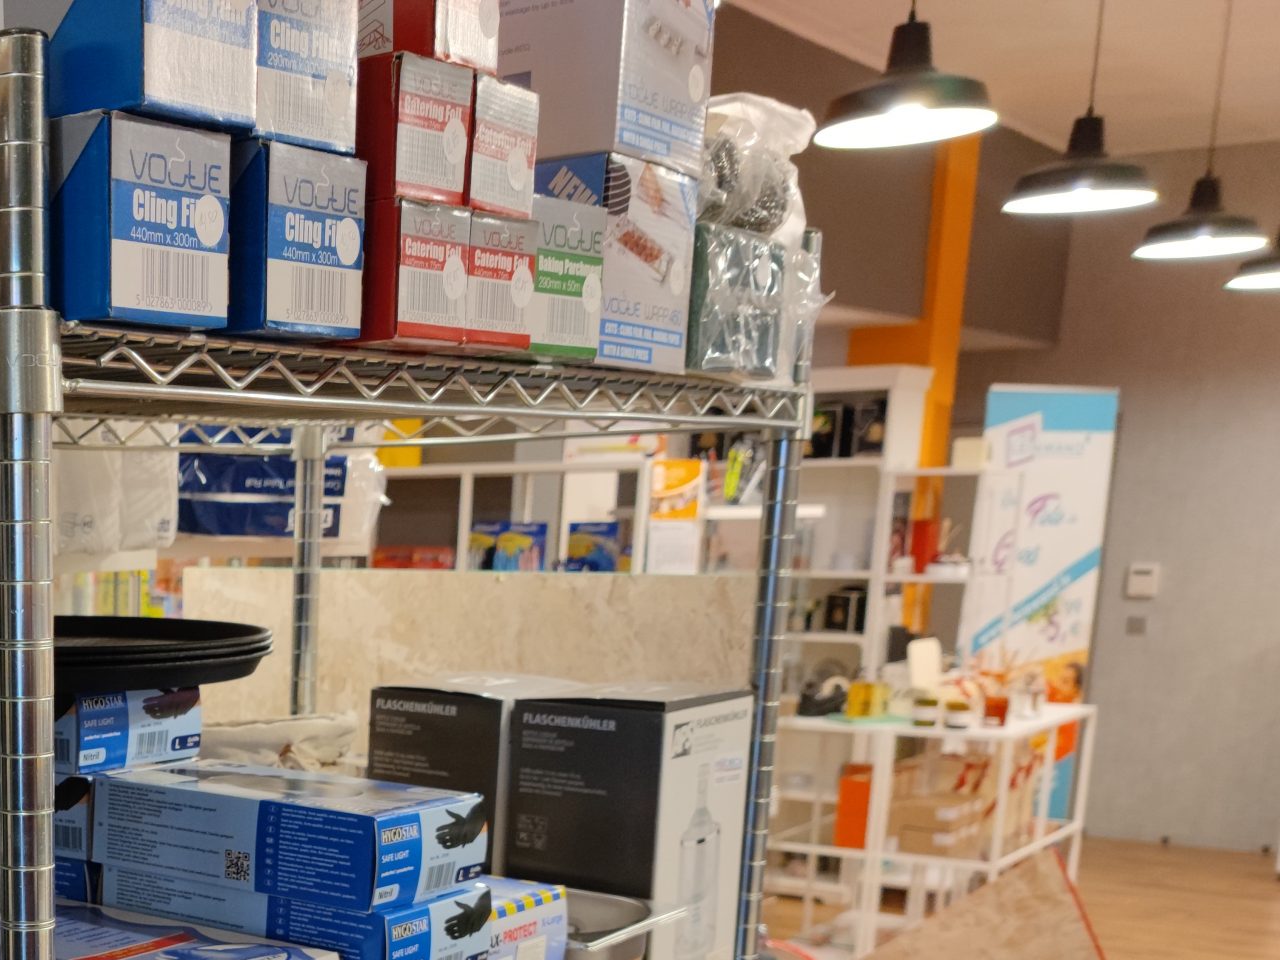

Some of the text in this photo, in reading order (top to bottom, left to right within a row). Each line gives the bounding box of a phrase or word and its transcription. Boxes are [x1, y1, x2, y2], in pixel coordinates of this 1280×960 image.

[271, 20, 308, 57] Cling
[405, 94, 443, 122] Catering
[129, 147, 222, 194] VOGUE
[284, 174, 359, 215] VOGUE
[133, 188, 177, 229] Cling
[130, 226, 198, 248] 440mm x 300m
[285, 211, 322, 249] Cling
[414, 214, 456, 239] VOGUE
[541, 218, 604, 255] VOGUE
[405, 238, 462, 262] Catering Foil
[484, 228, 525, 251] VOGUE
[282, 246, 309, 261] 440mm
[317, 251, 338, 266] 300m
[475, 249, 529, 272] Catering Foil
[538, 255, 563, 276] Baking
[83, 696, 124, 711] HYGOSTAR
[376, 697, 458, 716] FLASCHENKÜHLER
[84, 719, 97, 728] SAFE
[523, 712, 617, 732] FLASCHENKÜHLER
[175, 738, 181, 749] L
[83, 751, 101, 761] Nitril
[382, 824, 418, 844] HYGOSTAR
[382, 850, 409, 863] SAFE LIGHT
[392, 917, 429, 941] HYGOSTAR
[392, 944, 419, 960] SAFE LIGHT
